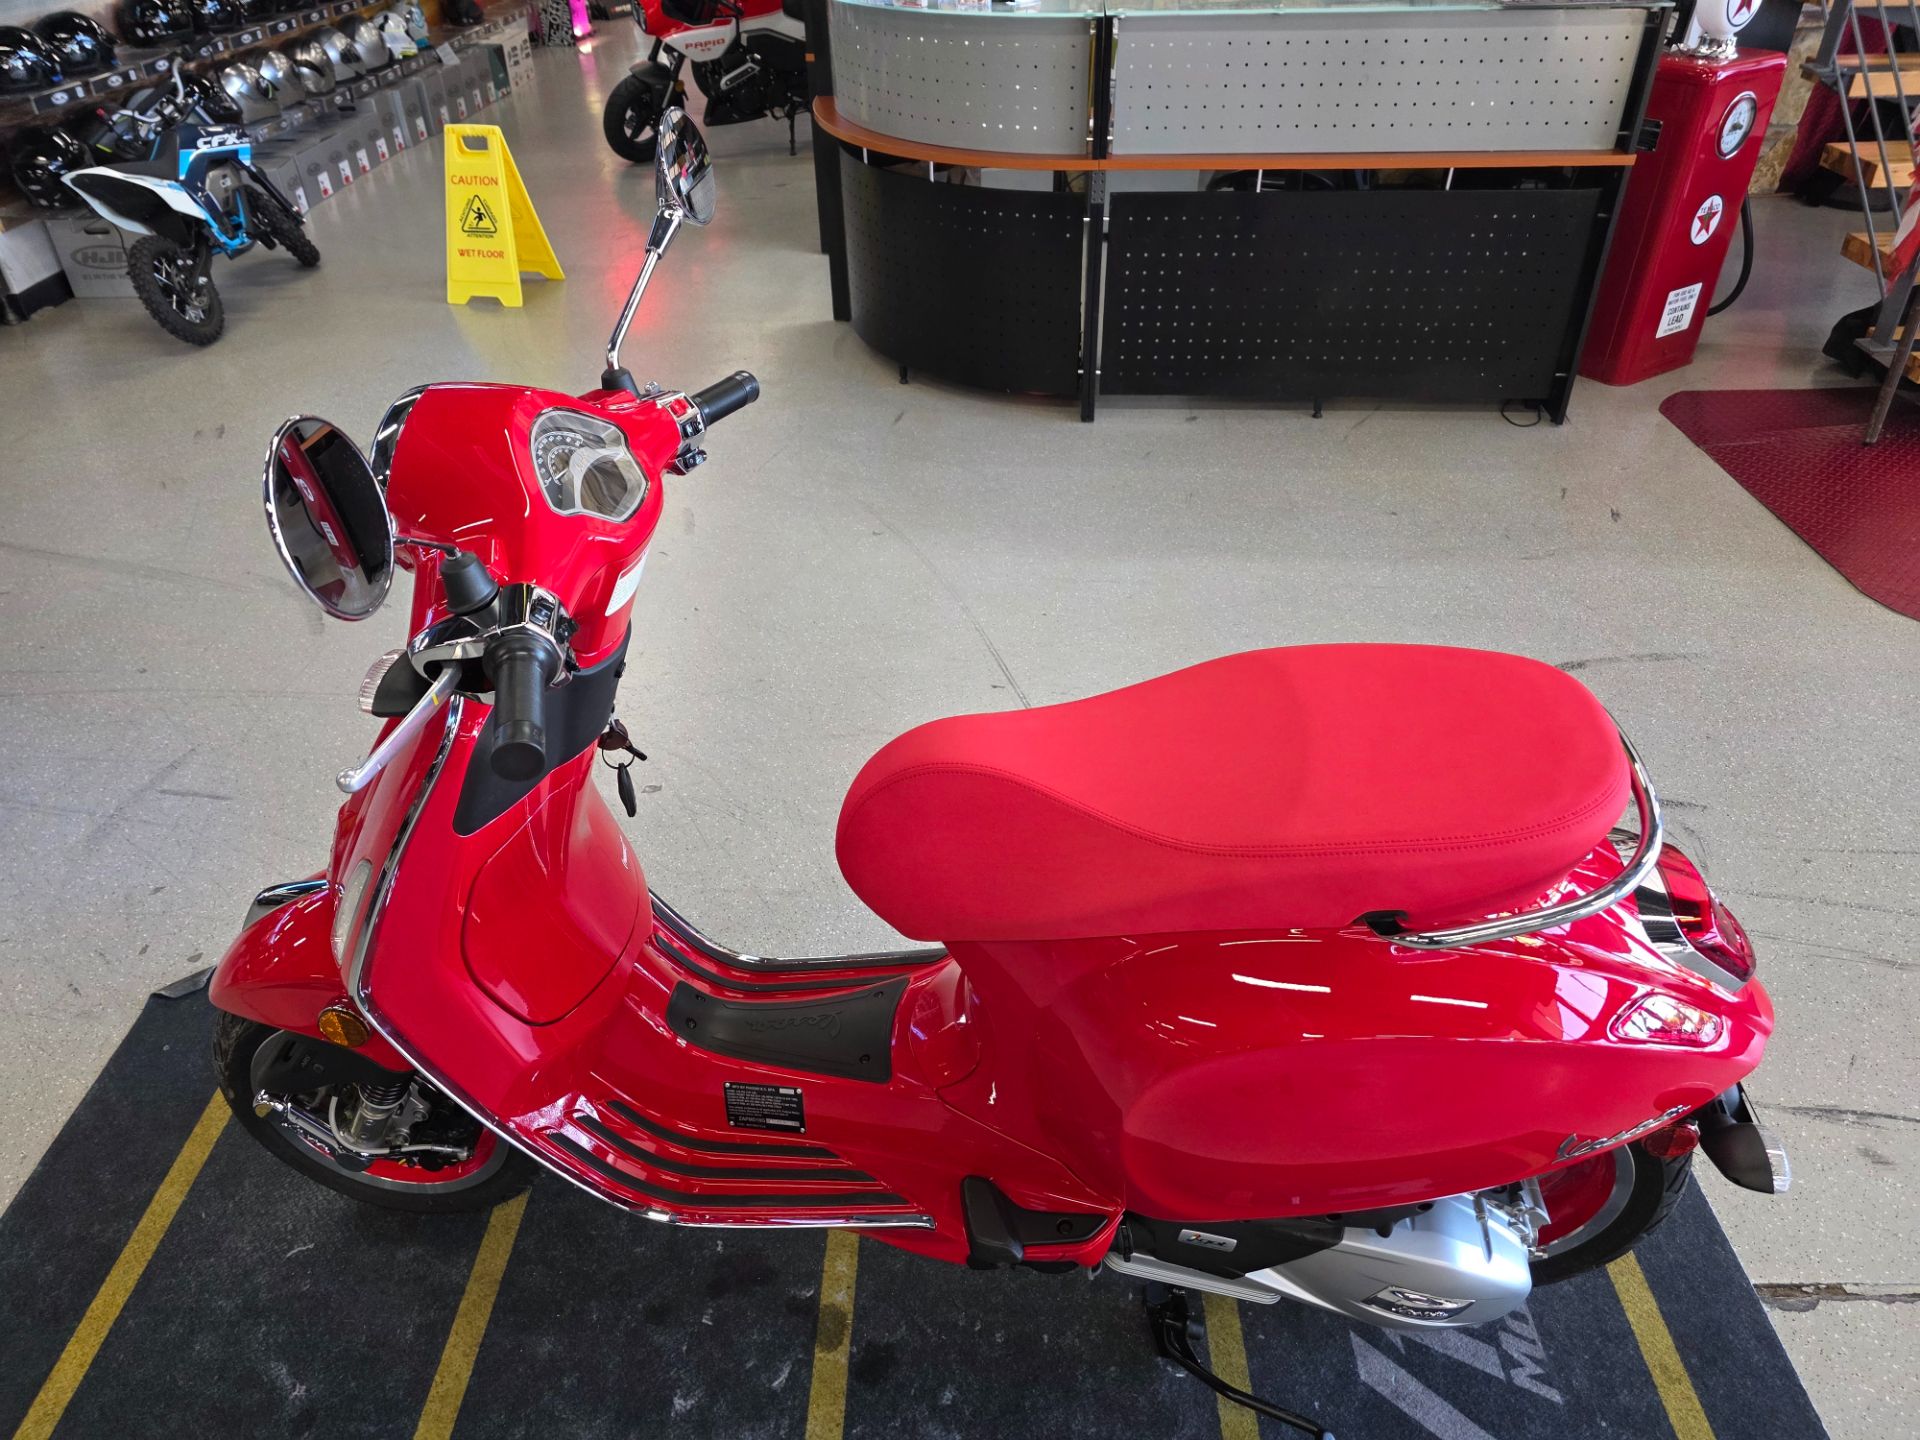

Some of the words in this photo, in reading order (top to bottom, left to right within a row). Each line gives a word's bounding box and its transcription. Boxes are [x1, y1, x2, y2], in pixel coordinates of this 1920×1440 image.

[685, 38, 726, 50] PAPIO
[450, 175, 499, 186] CAUTION
[457, 248, 476, 257] WET
[477, 249, 505, 259] FLOOR
[1667, 303, 1691, 316] CONTAINS
[1667, 313, 1684, 326] LEAD
